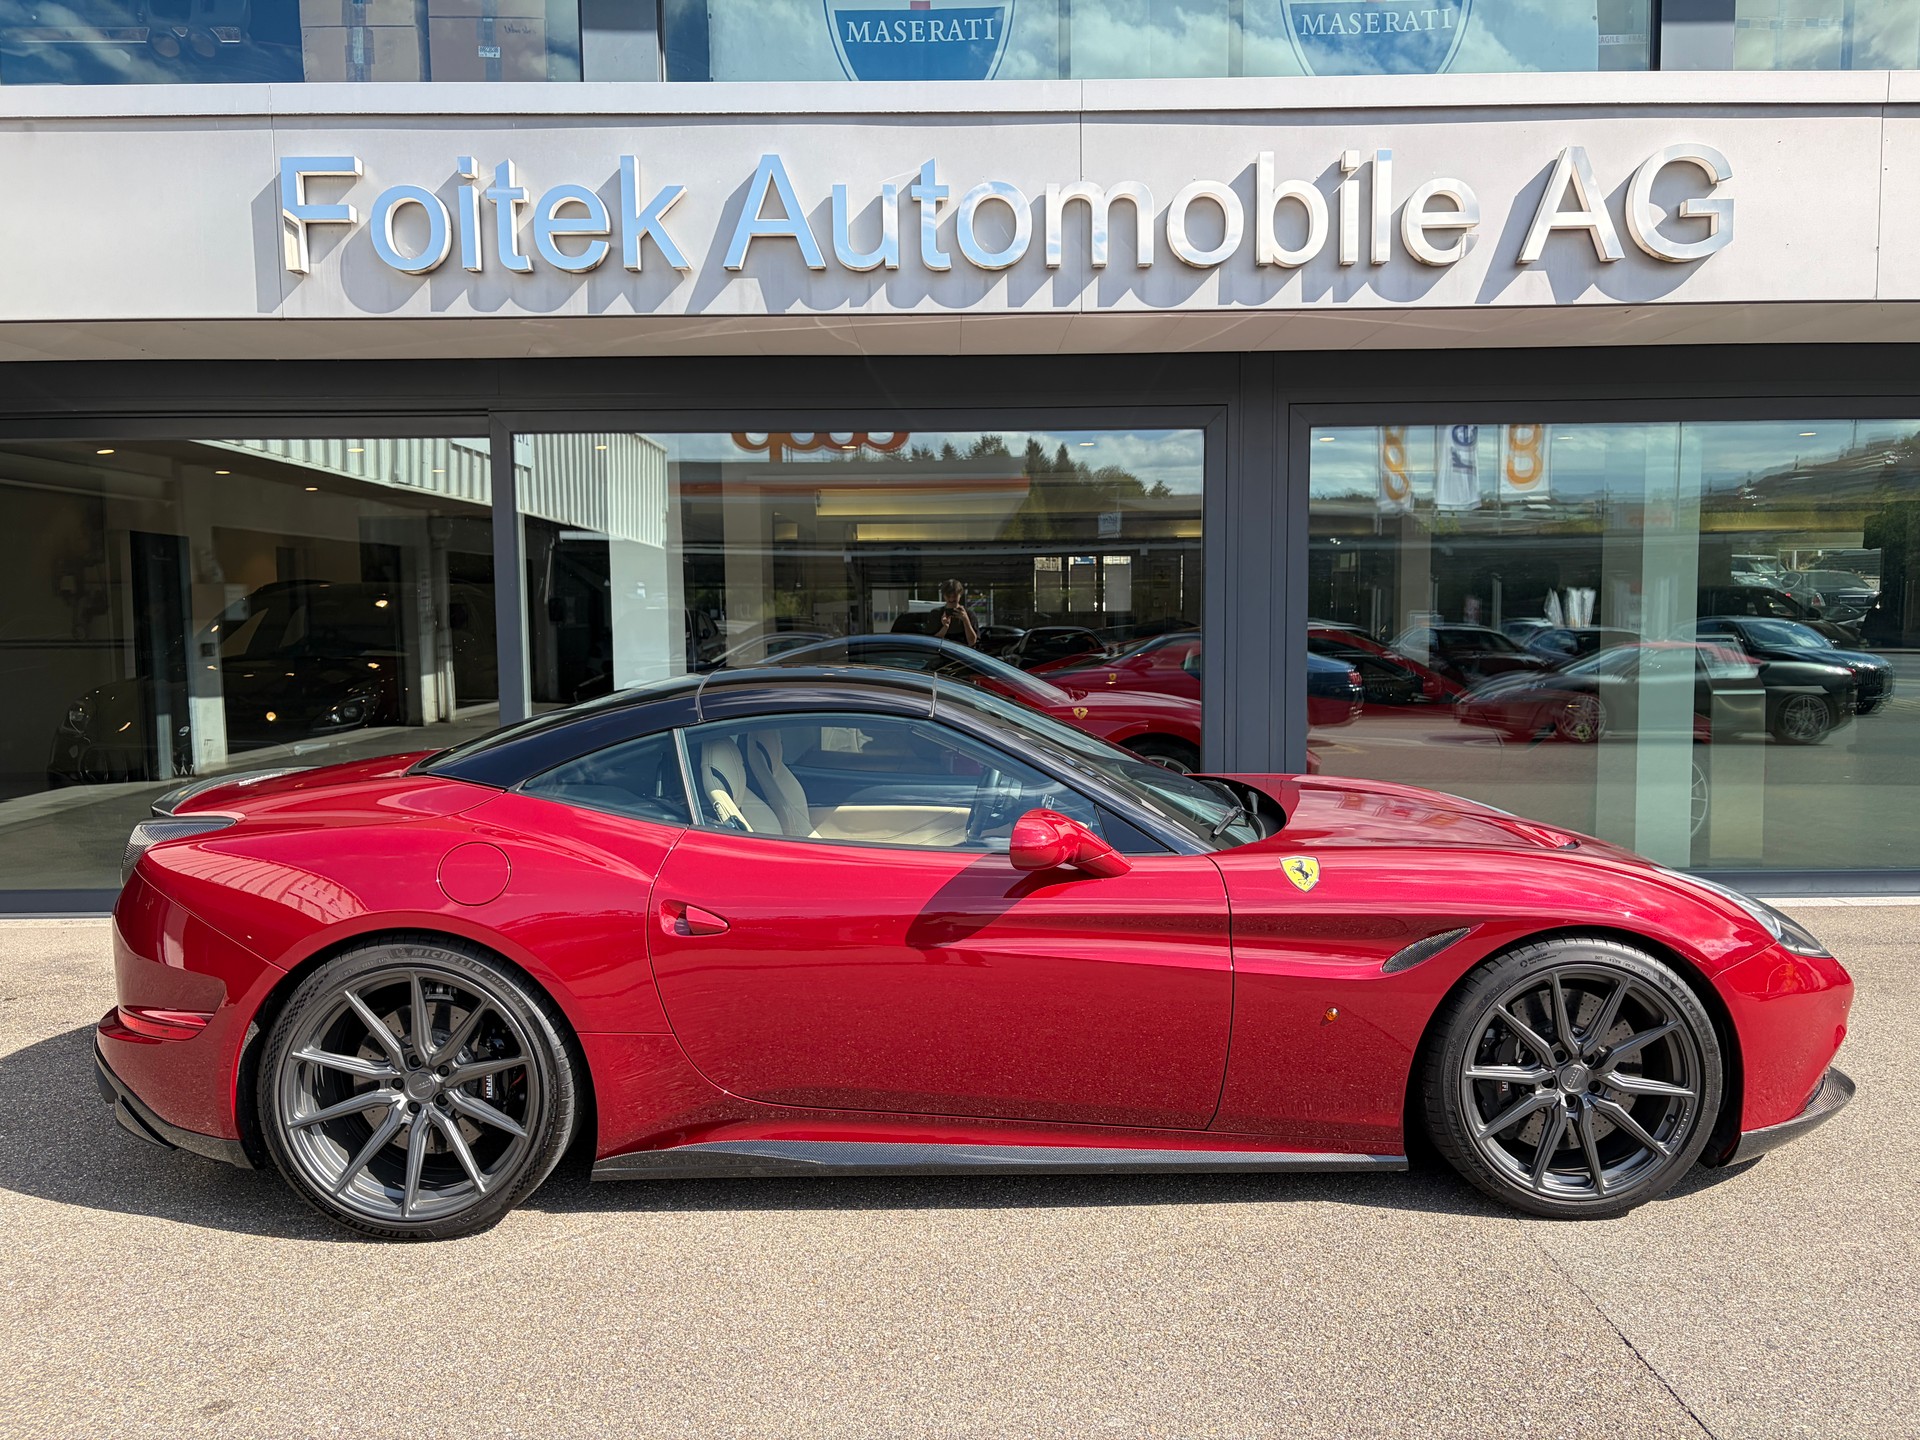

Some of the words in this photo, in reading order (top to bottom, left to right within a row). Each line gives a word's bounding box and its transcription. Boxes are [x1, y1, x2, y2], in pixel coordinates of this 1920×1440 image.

[845, 17, 995, 43] MASERATI
[1300, 8, 1453, 35] MASERATI
[280, 154, 693, 275] Foitek
[723, 149, 1480, 272] Automobile
[1516, 143, 1735, 263] AG
[411, 949, 485, 973] MICHELIN
